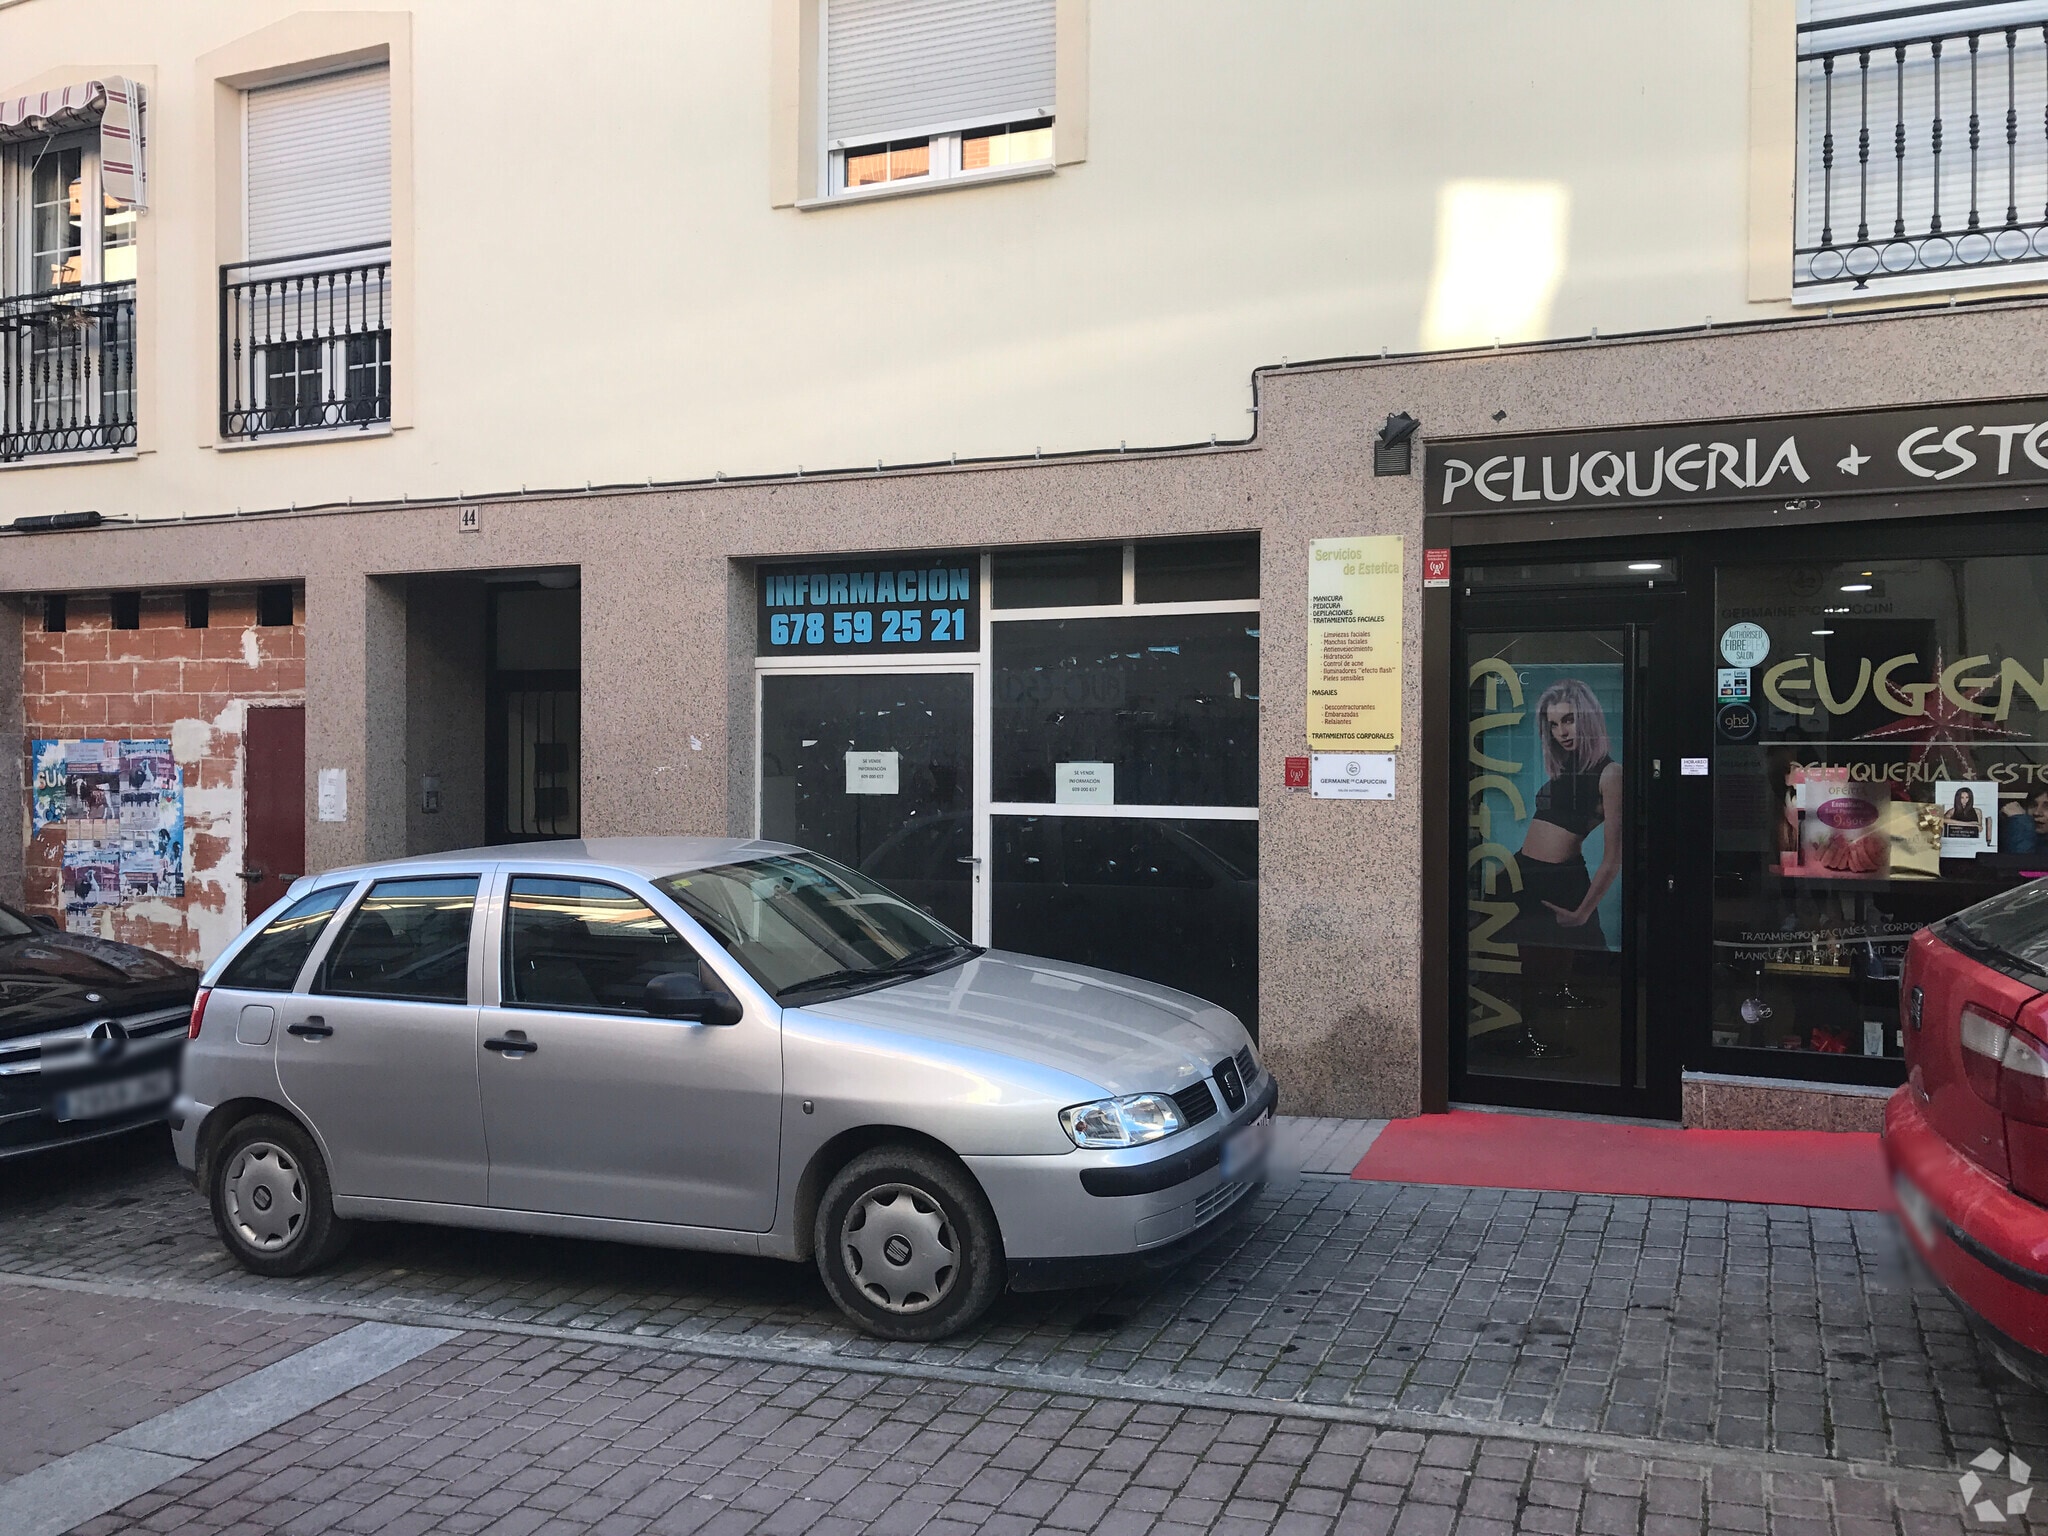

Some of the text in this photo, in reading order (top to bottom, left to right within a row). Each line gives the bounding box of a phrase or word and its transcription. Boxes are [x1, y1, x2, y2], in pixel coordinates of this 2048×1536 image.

[1442, 435, 1811, 505] PELUQUERIA
[462, 509, 476, 526] 44
[1315, 547, 1362, 561] Servicios
[1343, 561, 1400, 576] de Estetica
[766, 559, 970, 607] INFORMACIÓN
[1313, 616, 1356, 624] TRATAMIENTOS
[1721, 606, 1796, 620] GERMAINE
[770, 608, 965, 645] 678 59 25 21
[1728, 630, 1763, 640] AUTHORISED
[1724, 639, 1766, 651] FIBREPLEX
[1736, 651, 1754, 660] SALON
[1725, 713, 1750, 730] ghd
[1312, 732, 1394, 740] TRATAMIENTOS CORPORALES
[1787, 760, 1952, 784] PELUQUERIA
[1469, 657, 1527, 1039] EUGENIA
[1740, 930, 1816, 941] TRATAMIENTOS
[1819, 924, 1867, 938] FACIALES
[1871, 925, 1879, 933] Y
[1891, 945, 1905, 955] DE
